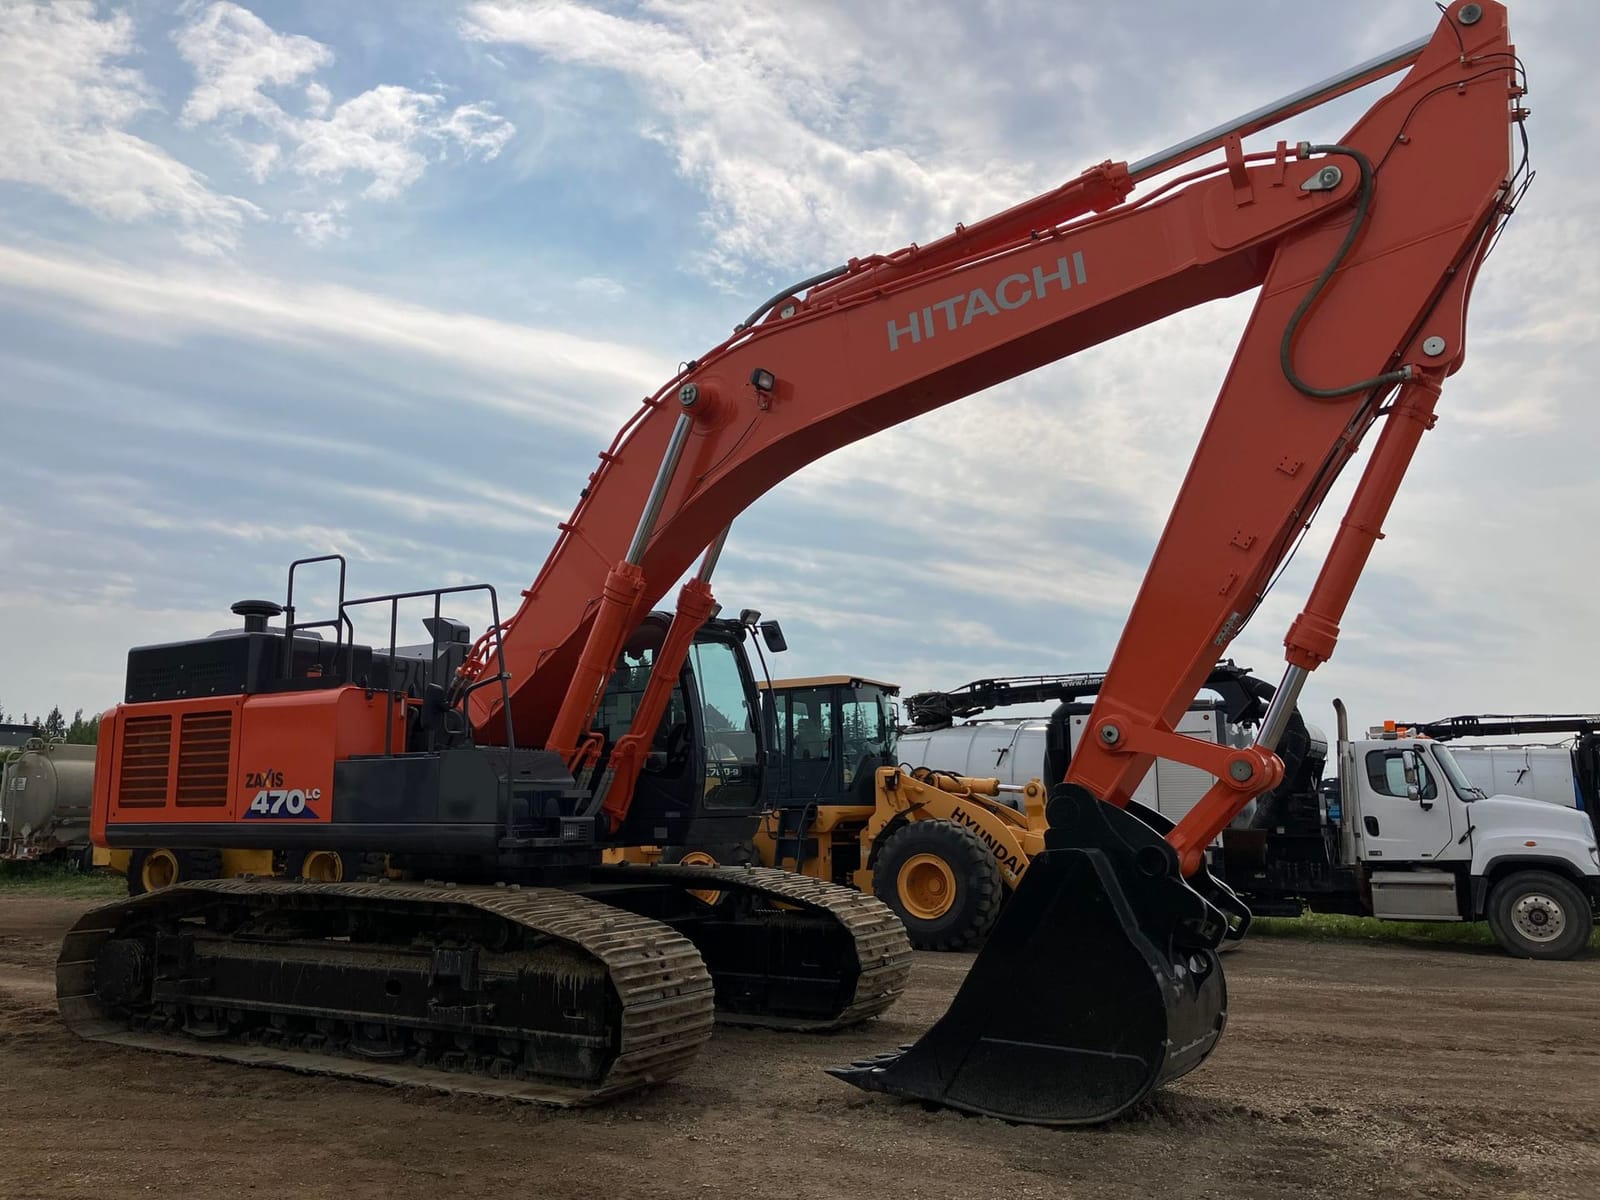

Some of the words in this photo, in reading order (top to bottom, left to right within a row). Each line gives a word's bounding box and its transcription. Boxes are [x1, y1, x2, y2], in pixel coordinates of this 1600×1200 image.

[887, 251, 1087, 351] HITACHI
[245, 768, 284, 788] ZAXIS
[950, 806, 1025, 877] HYUNDAI
